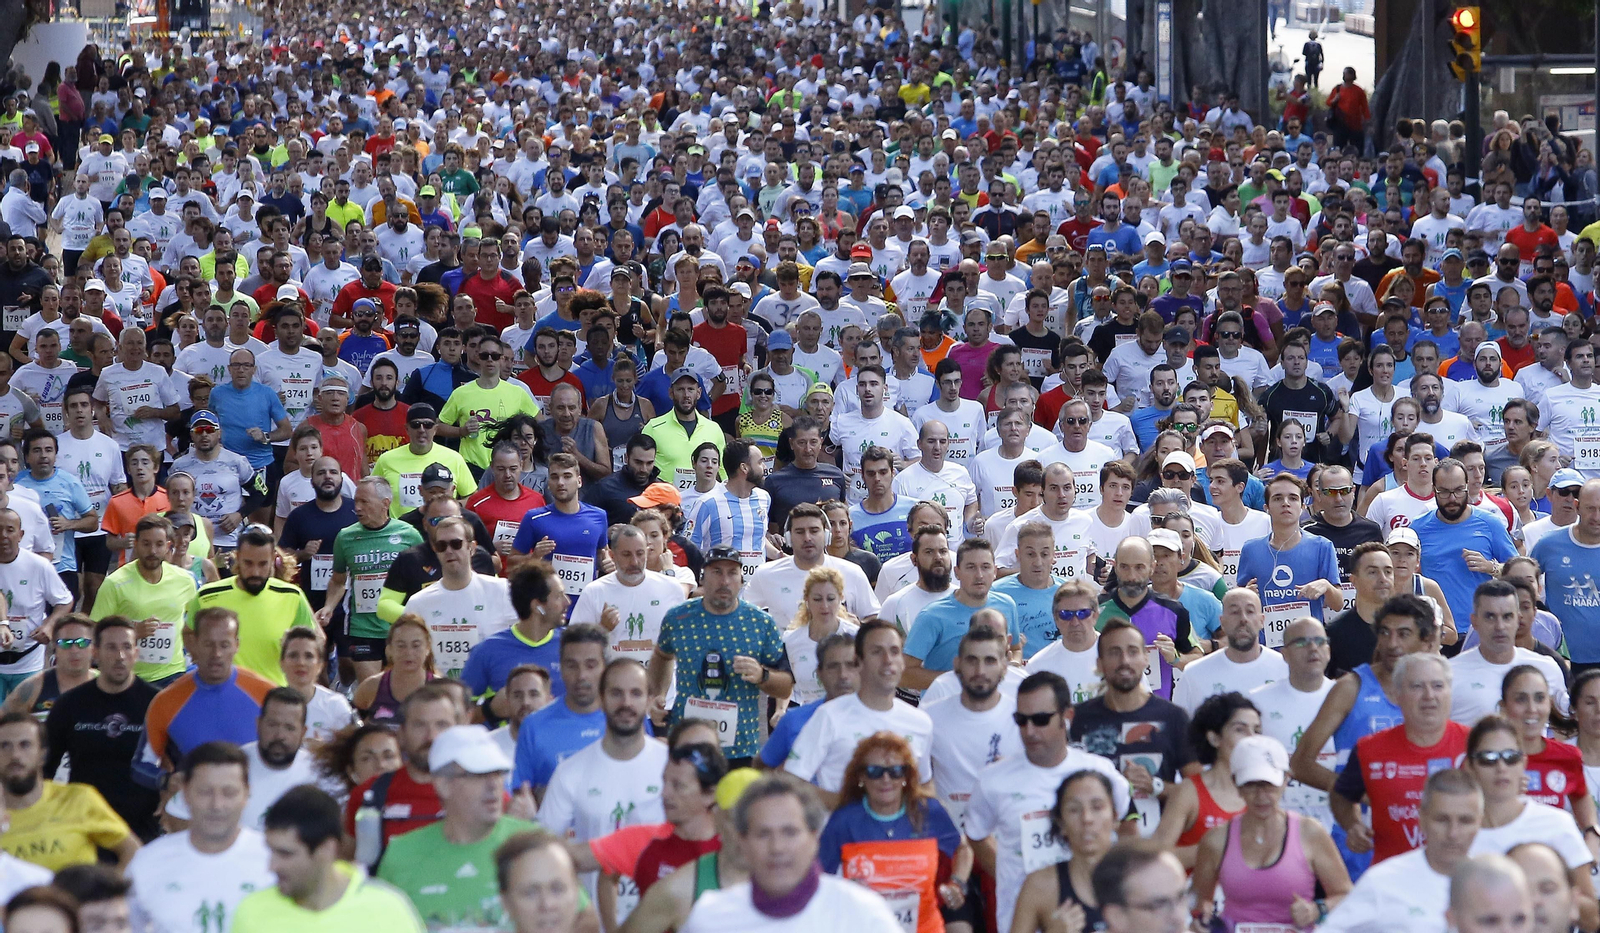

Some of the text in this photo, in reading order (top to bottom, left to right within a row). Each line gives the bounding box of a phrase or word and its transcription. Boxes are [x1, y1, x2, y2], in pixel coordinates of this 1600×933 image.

[1026, 359, 1042, 367] 113
[127, 394, 151, 405] 3740
[287, 389, 309, 399] 3741
[45, 412, 64, 422] 986
[946, 449, 967, 459] 252
[1580, 448, 1600, 458] 918
[354, 549, 400, 564] mijas
[558, 568, 587, 582] 9851
[742, 564, 759, 576] 90
[1264, 588, 1300, 600] mayor
[1572, 597, 1600, 608] MARA
[1268, 617, 1297, 633] 180
[139, 637, 172, 650] 8509
[437, 640, 470, 653] 1583
